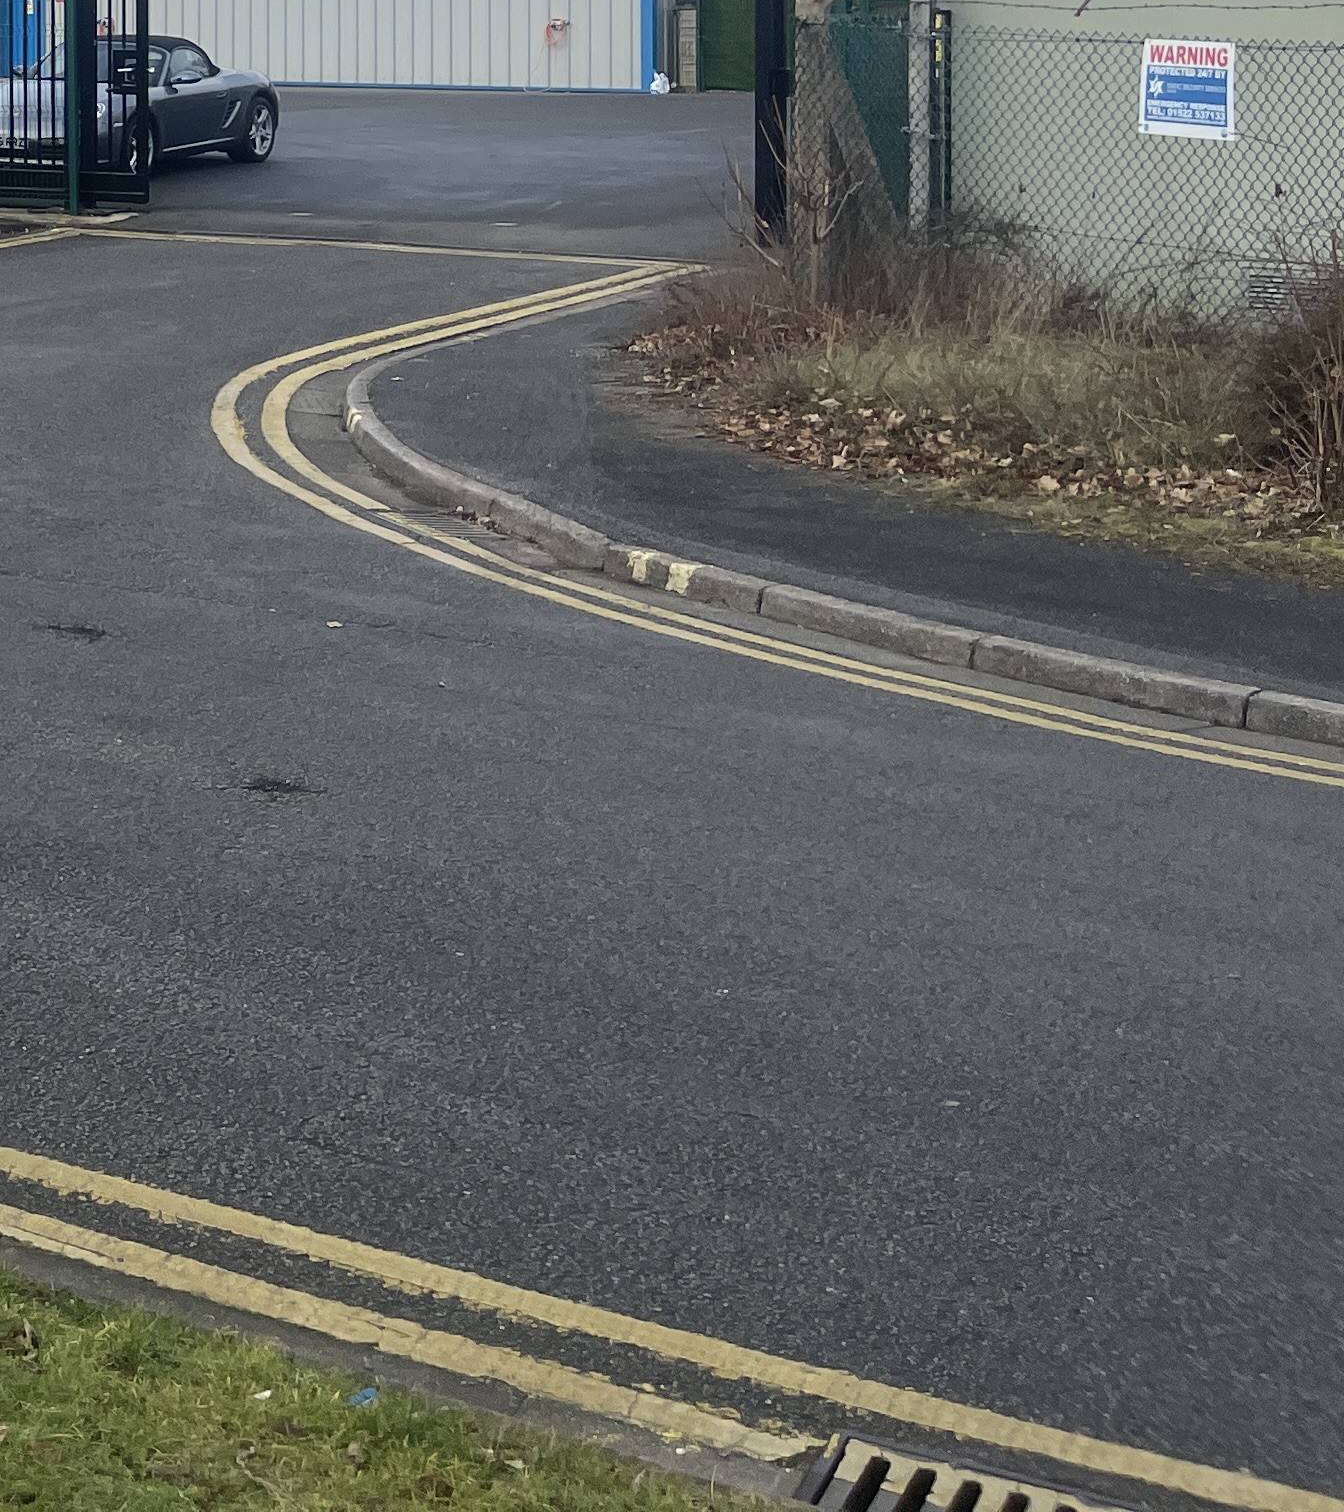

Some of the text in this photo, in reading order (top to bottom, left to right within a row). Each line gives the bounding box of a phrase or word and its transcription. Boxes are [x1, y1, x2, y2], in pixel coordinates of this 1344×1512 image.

[1150, 45, 1229, 67] WARNING
[1149, 66, 1196, 77] PROTECTED
[1147, 107, 1166, 116] TEL:
